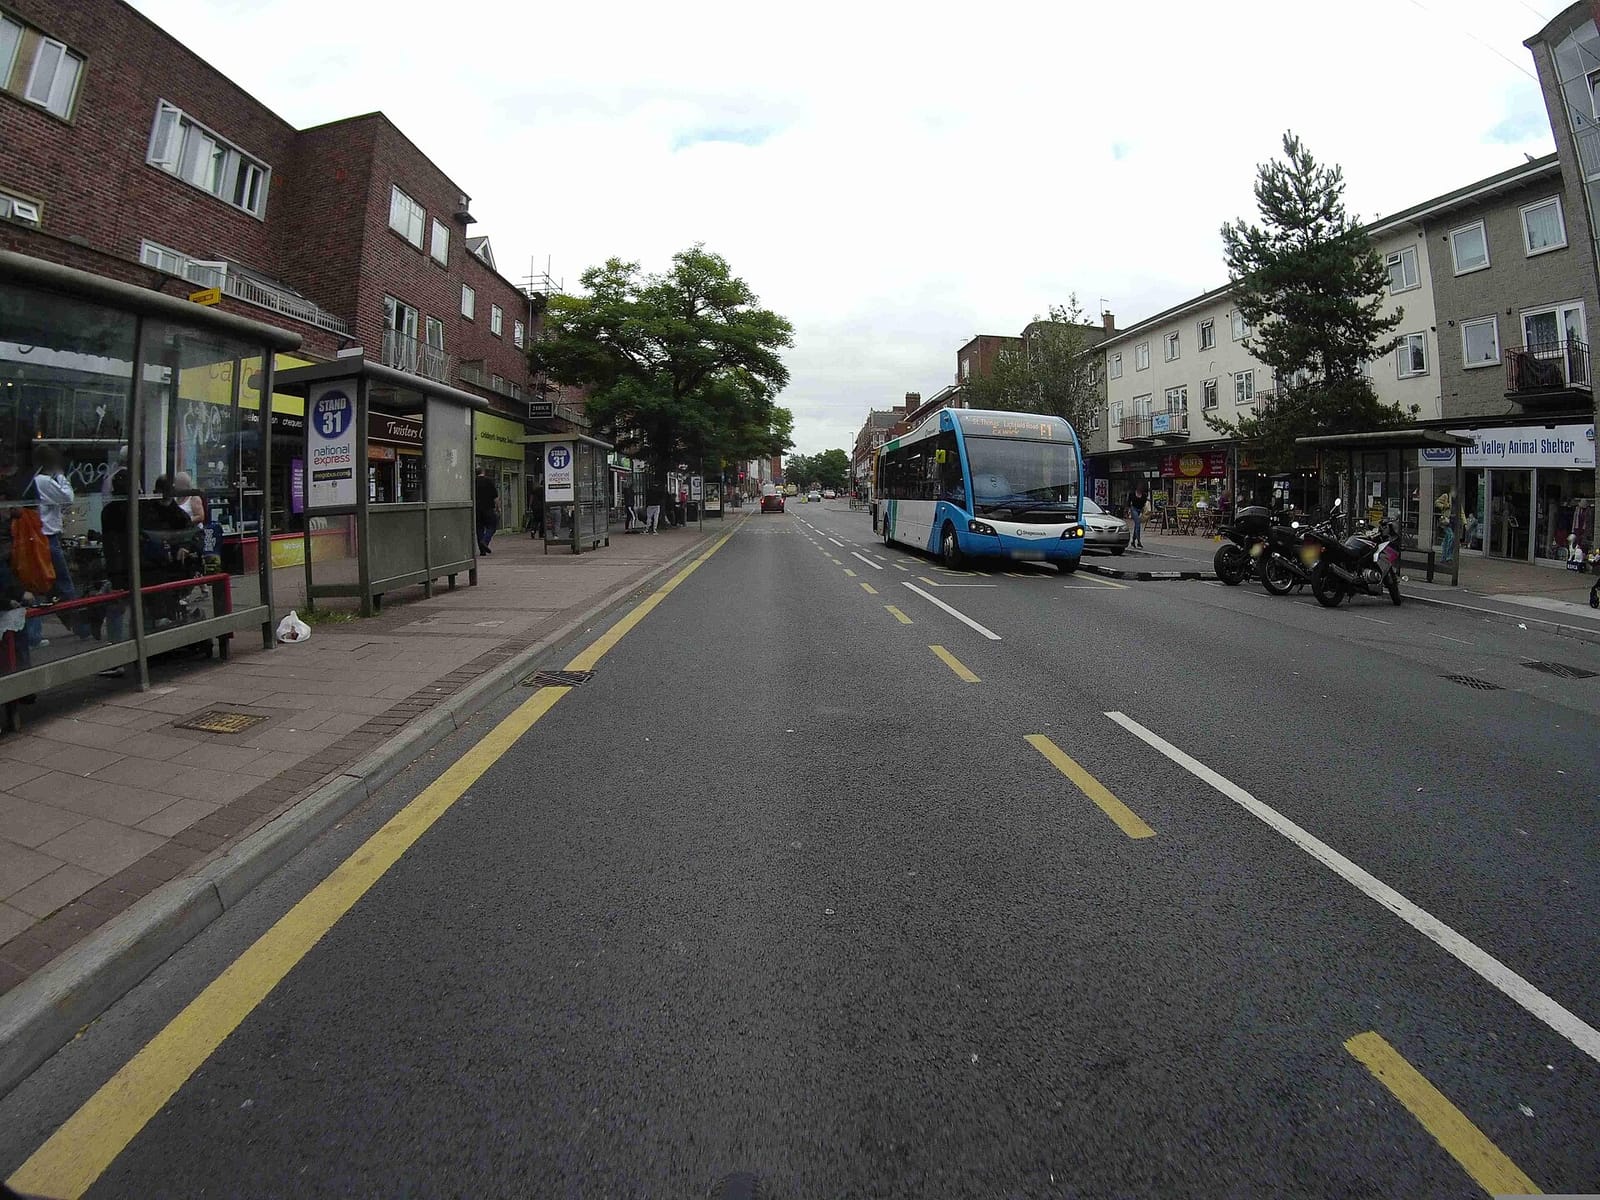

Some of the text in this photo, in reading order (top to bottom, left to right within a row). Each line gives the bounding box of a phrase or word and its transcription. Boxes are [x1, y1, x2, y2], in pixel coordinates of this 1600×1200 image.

[318, 398, 347, 412] STAND
[322, 411, 342, 434] 31
[386, 421, 418, 438] Twisters
[313, 443, 350, 457] national
[551, 449, 567, 457] STAND
[1481, 440, 1506, 458] Valley
[1509, 439, 1538, 454] Animal
[1541, 438, 1575, 454] Shelter
[313, 454, 351, 467] express
[553, 456, 565, 467] 31
